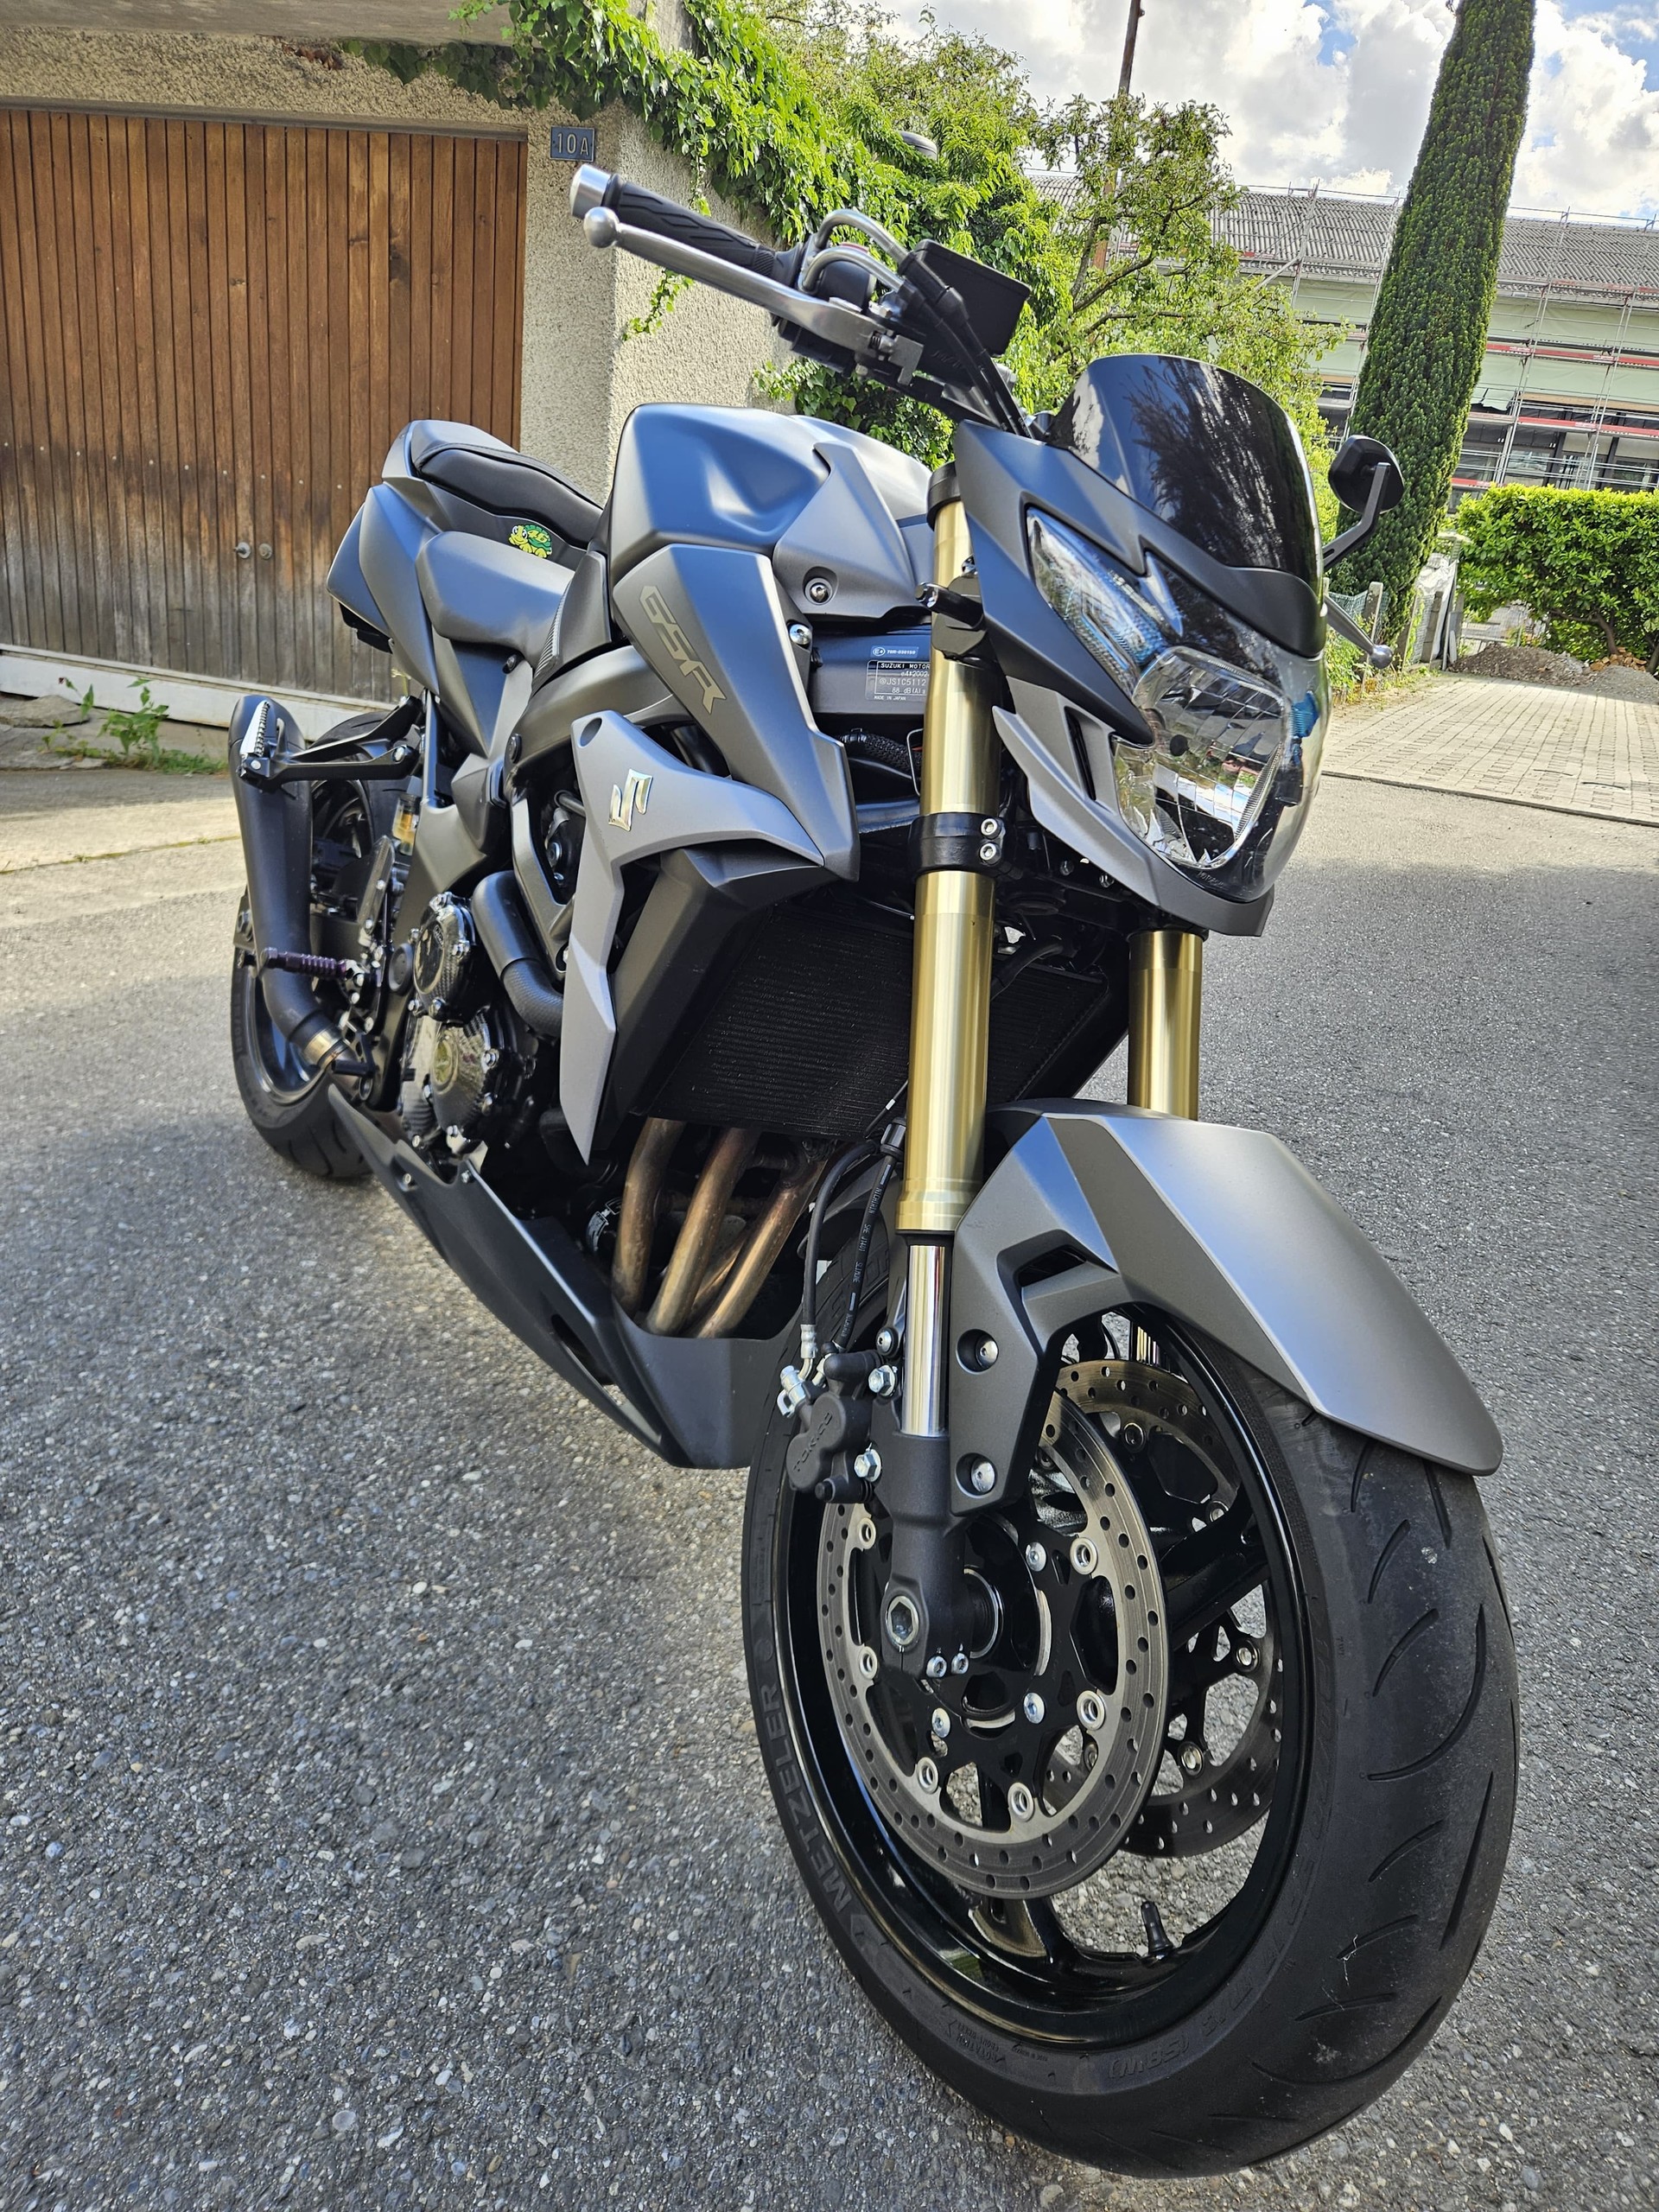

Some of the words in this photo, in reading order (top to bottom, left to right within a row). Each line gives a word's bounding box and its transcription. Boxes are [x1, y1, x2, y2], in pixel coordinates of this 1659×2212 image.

[557, 133, 588, 156] 10A
[528, 530, 549, 543] 46
[639, 585, 727, 715] GSR
[868, 1187, 882, 1214] NICHIRIN
[793, 1411, 833, 1472] TOKICO
[760, 1685, 853, 1913] METZELER
